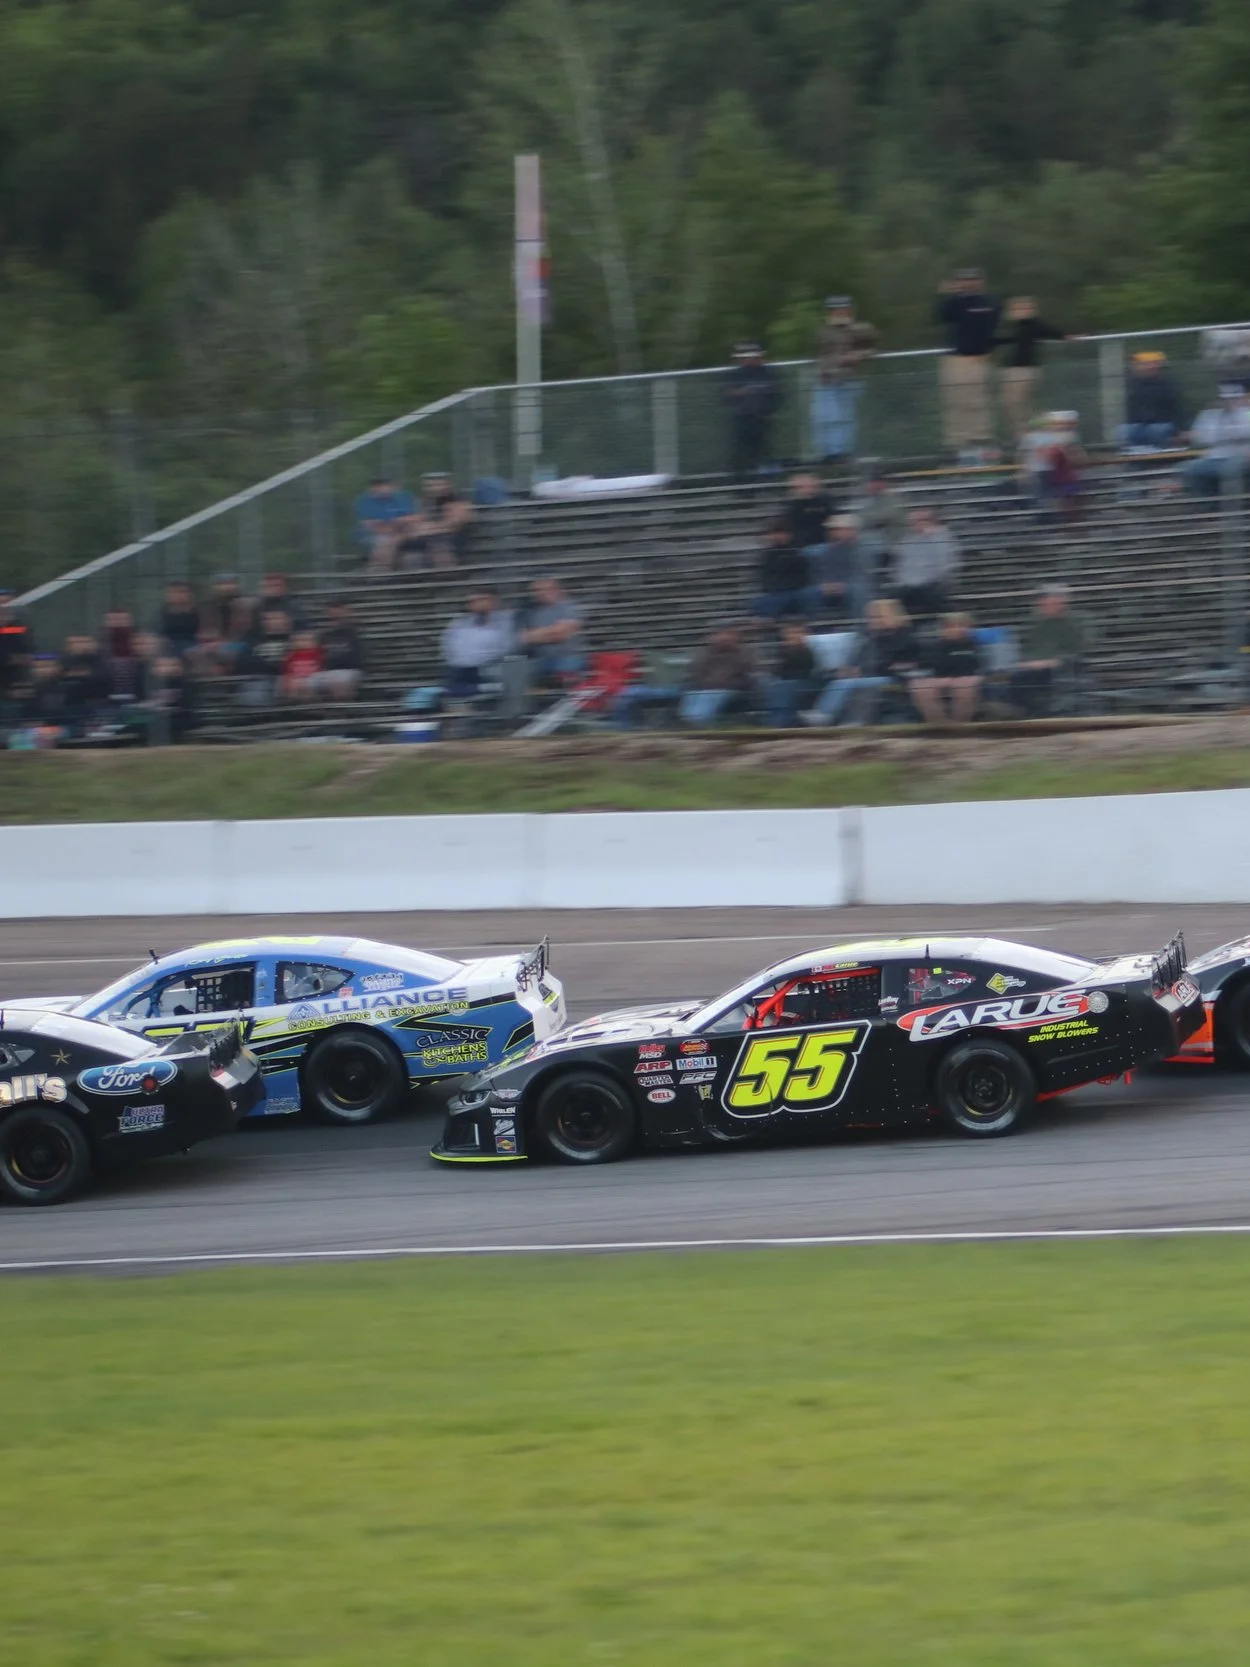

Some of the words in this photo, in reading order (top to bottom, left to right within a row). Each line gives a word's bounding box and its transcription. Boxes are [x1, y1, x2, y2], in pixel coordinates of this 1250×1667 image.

[288, 1013, 371, 1031] CONSULTING
[375, 1010, 385, 1018] &
[389, 1001, 469, 1017] EXCAVATION
[908, 989, 1086, 1042] LARUE
[1040, 1020, 1089, 1033] INDUSTRIAL
[416, 1029, 488, 1048] CLASSIC
[1028, 1033, 1054, 1042] SNOW
[1056, 1027, 1098, 1038] BLOWERS
[422, 1043, 486, 1057] KITCHENS
[447, 1052, 487, 1064] BATHS
[680, 1059, 704, 1069] Mobil
[637, 1062, 671, 1071] ARP
[730, 1029, 858, 1107] 55
[683, 1071, 716, 1081] PFC
